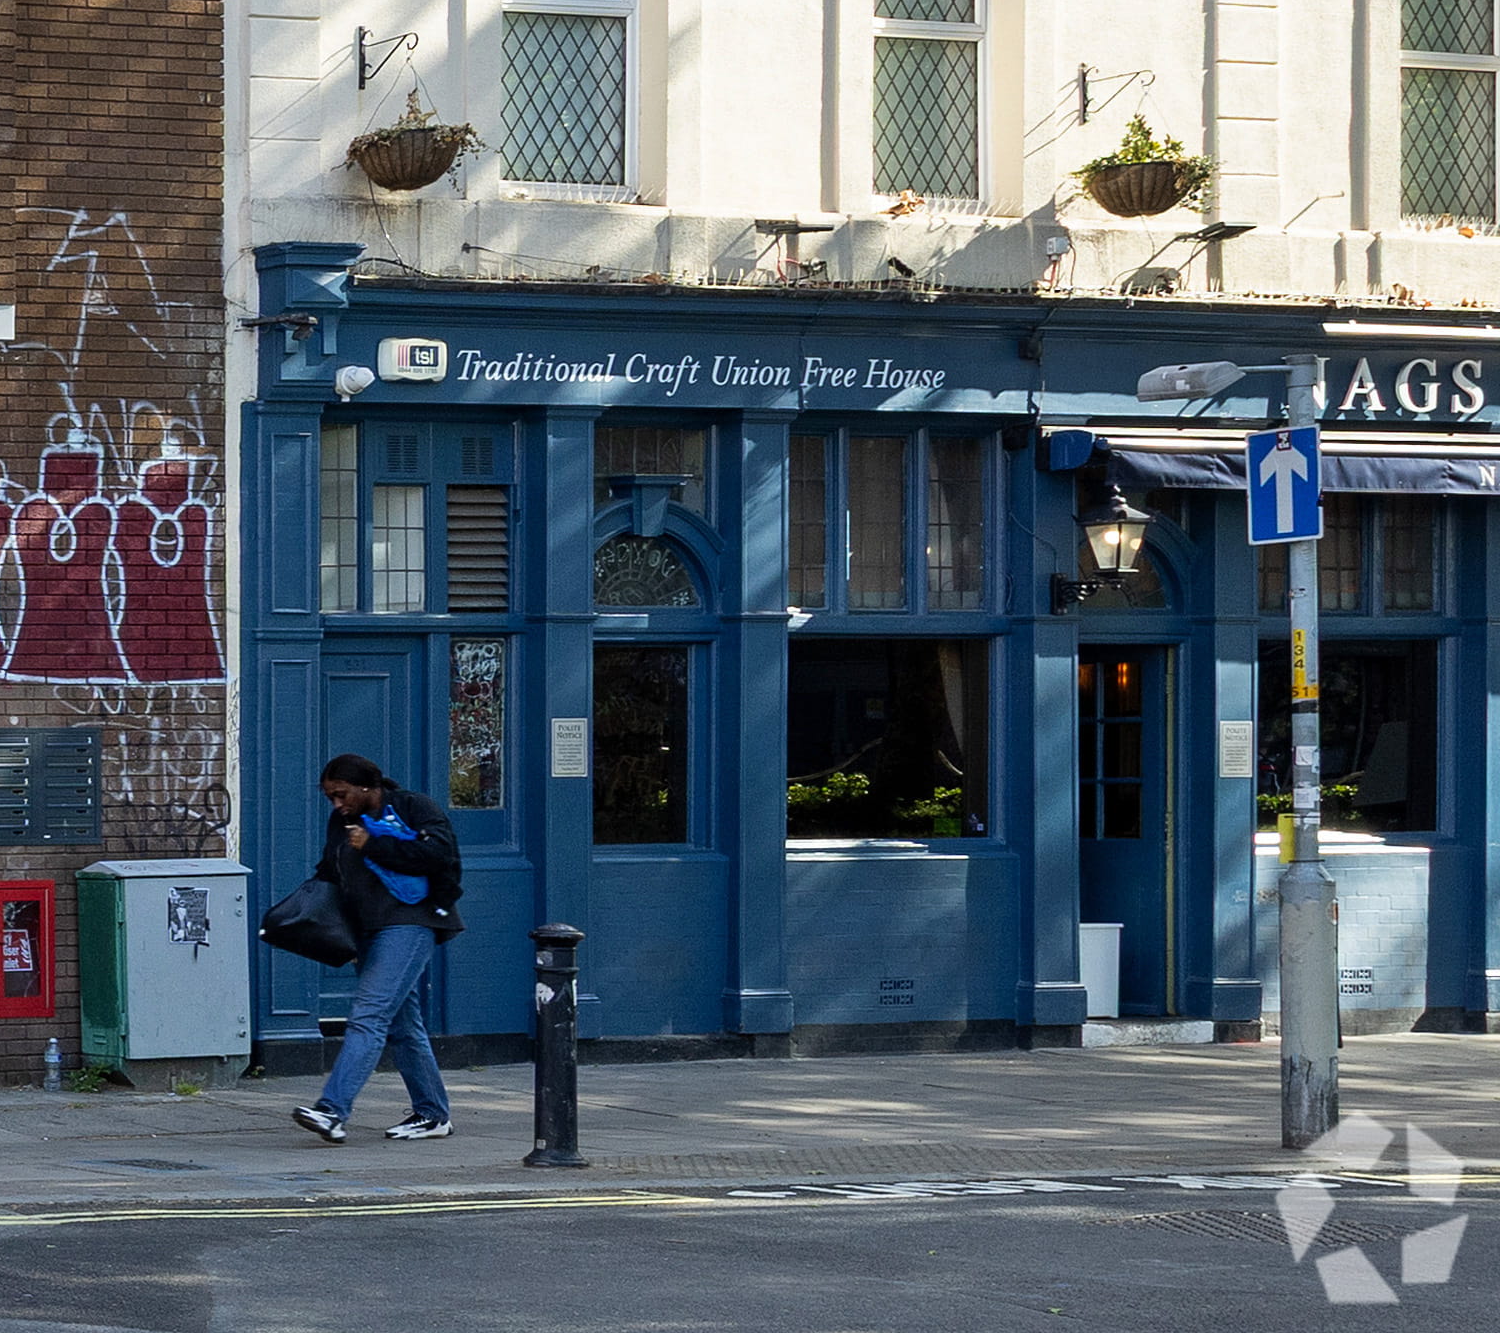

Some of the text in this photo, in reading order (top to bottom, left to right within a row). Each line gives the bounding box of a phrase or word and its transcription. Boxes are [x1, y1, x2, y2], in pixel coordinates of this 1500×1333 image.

[456, 349, 946, 397] Traditional Craft Union Free House
